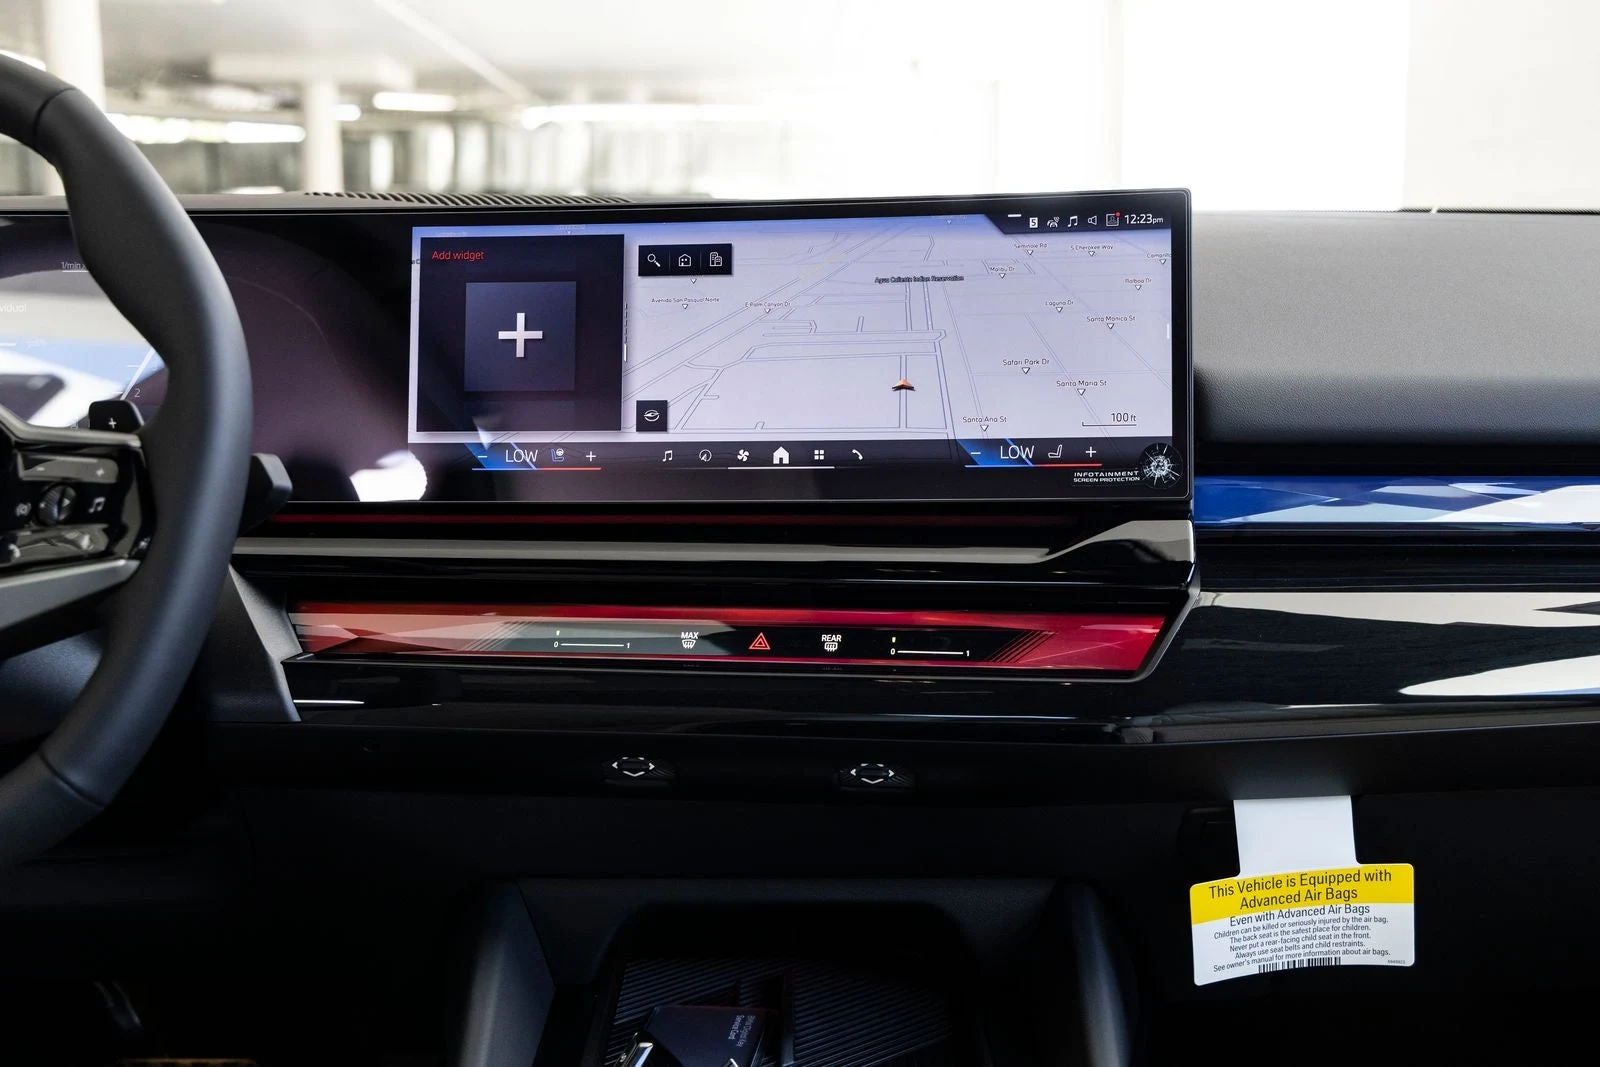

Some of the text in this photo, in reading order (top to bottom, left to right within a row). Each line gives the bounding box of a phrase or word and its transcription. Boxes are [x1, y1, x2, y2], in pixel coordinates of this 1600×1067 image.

[1124, 214, 1164, 224] 12:23pm
[432, 251, 485, 262] Add widget
[1111, 413, 1136, 422] 100 ft
[505, 449, 538, 462] LOW
[1000, 445, 1034, 459] LOW
[821, 634, 842, 642] REAR
[1209, 869, 1392, 899] This Vehicle is Equipped with
[1240, 888, 1358, 909] Advanced Air Bags
[1230, 904, 1370, 927] Even with Advanced Air Bags
[1214, 930, 1239, 939] Children
[1262, 922, 1279, 930] killed
[1288, 919, 1317, 927] seriously
[1318, 917, 1340, 925] injured
[1374, 916, 1388, 924] bag.
[1243, 934, 1257, 942] back
[1265, 936, 1299, 945] rear-facing
[1301, 934, 1317, 942] child
[1235, 951, 1258, 959] Always
[1285, 943, 1300, 951] belts
[1213, 964, 1225, 972] See
[1226, 959, 1250, 969] owner's
[1251, 954, 1274, 965] manual
[1284, 952, 1302, 960] more
[1303, 948, 1340, 957] information
[1372, 947, 1390, 956] bags.
